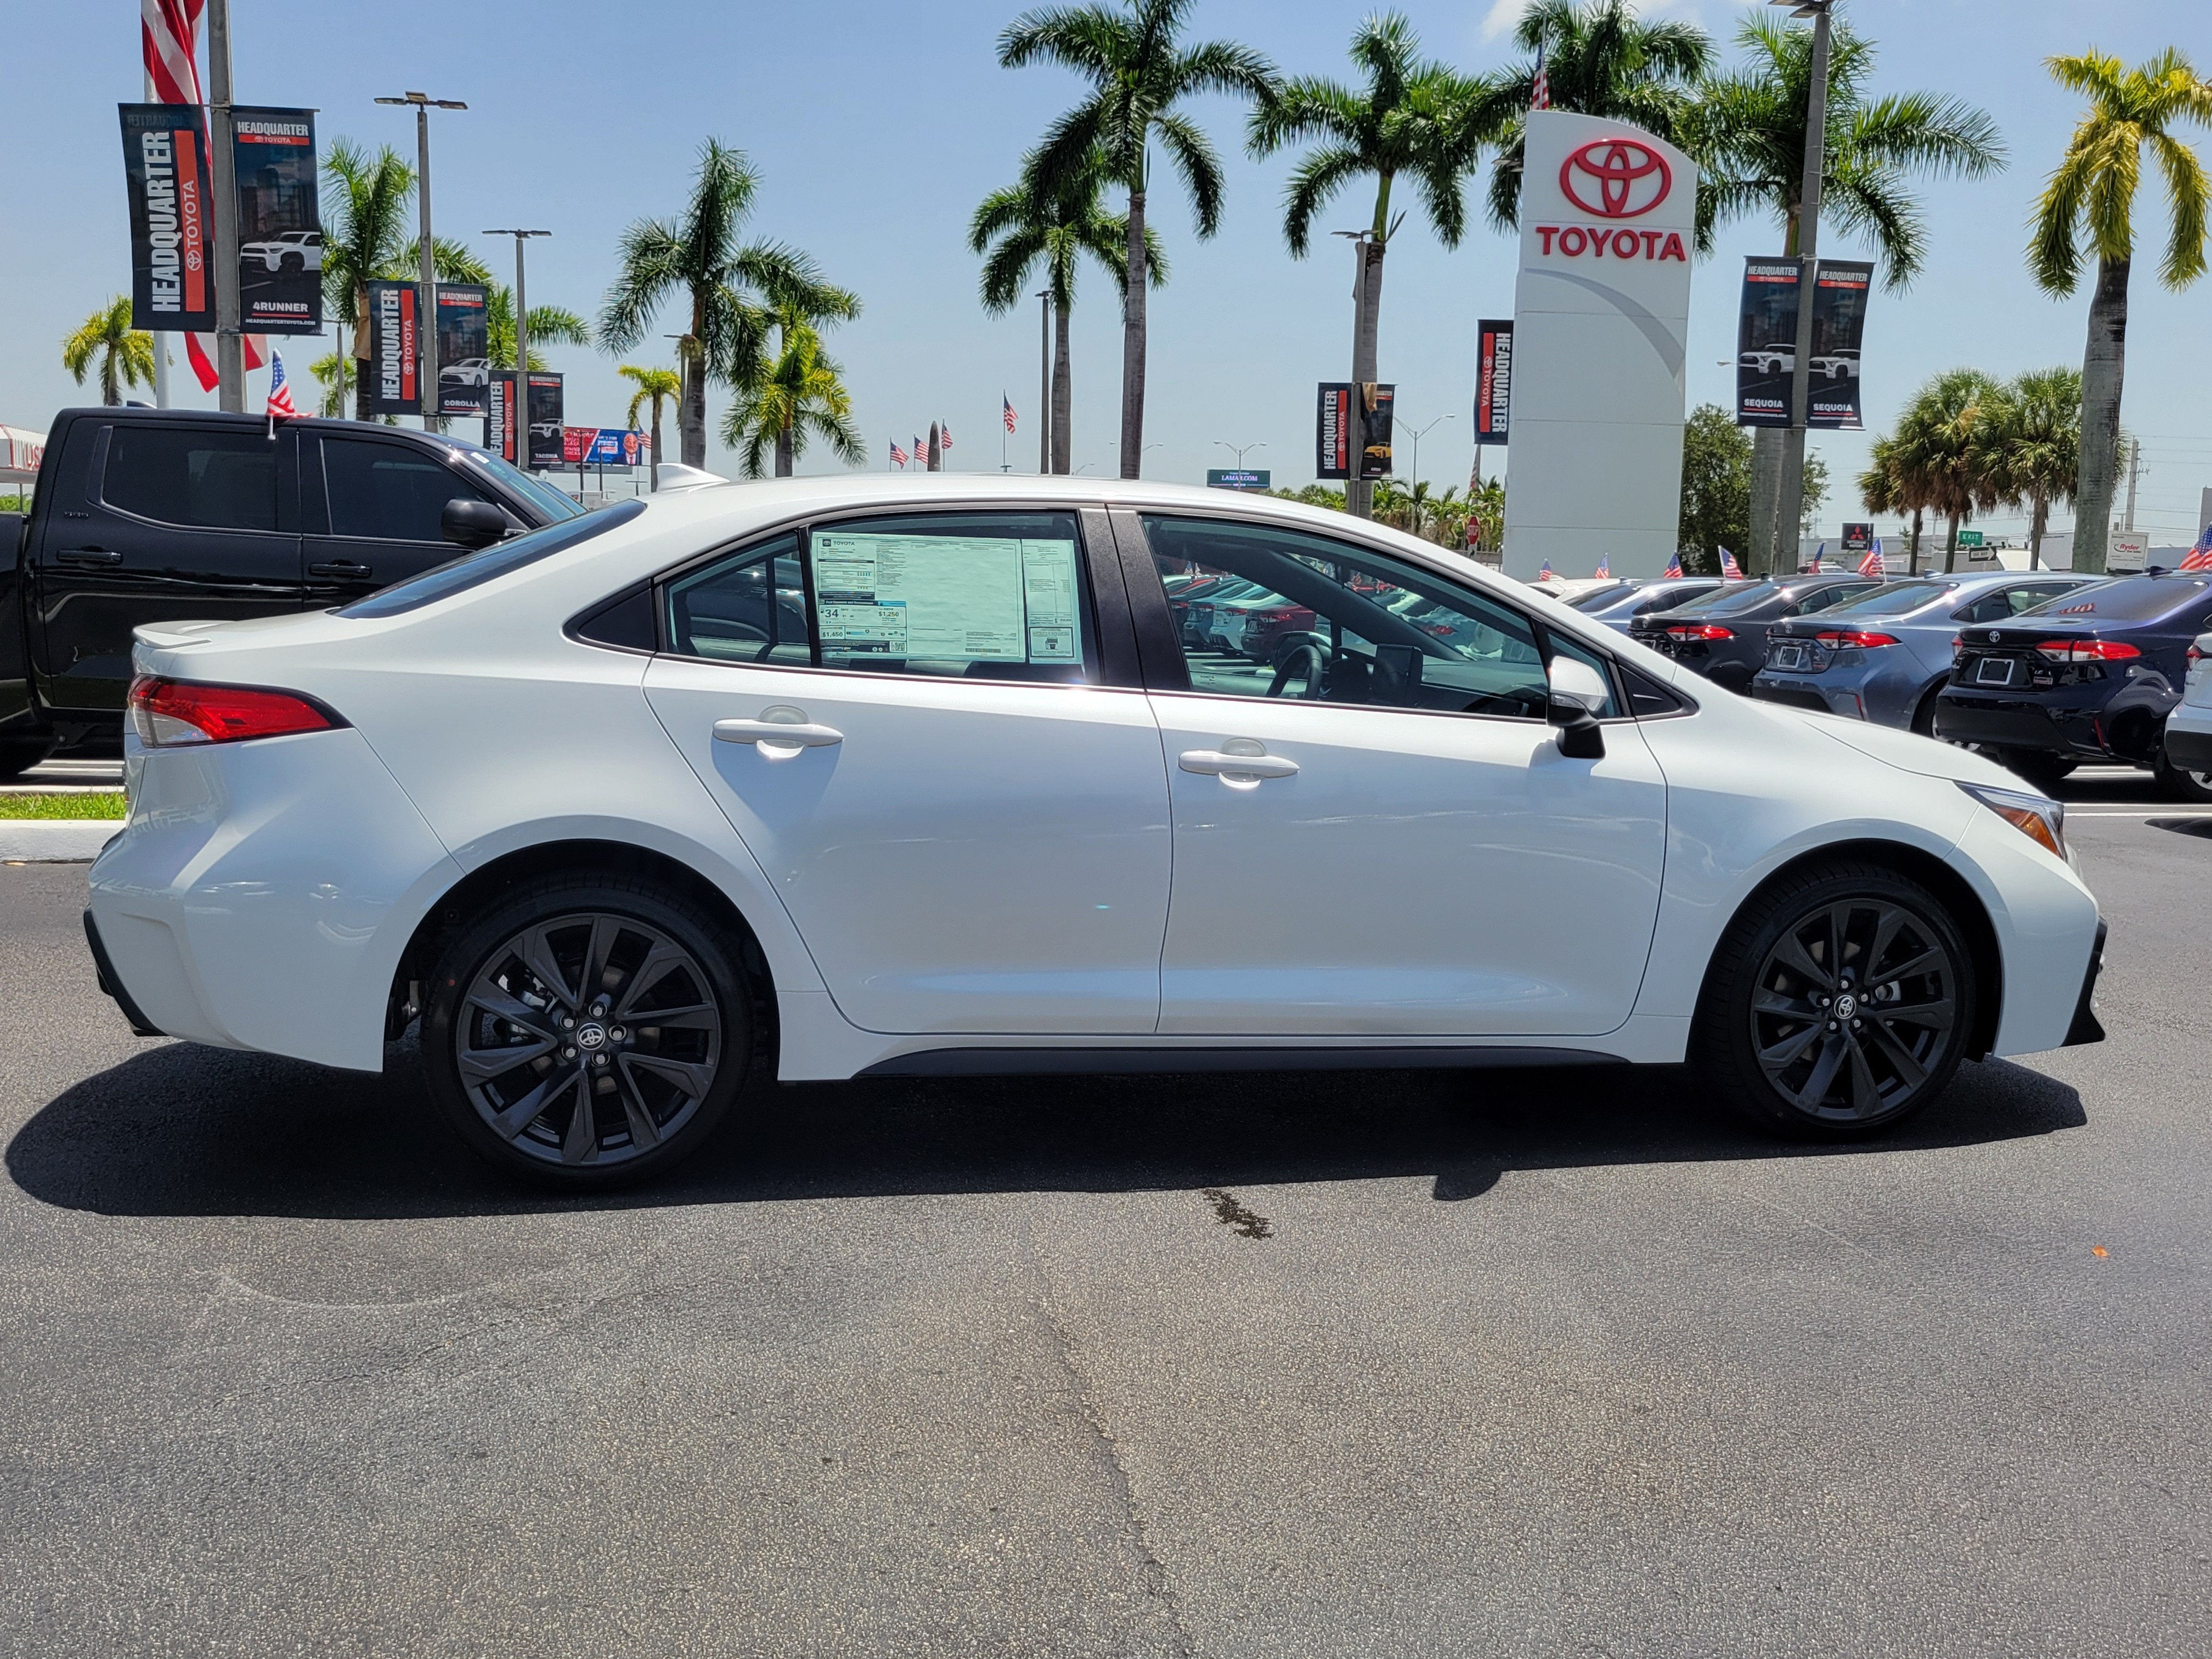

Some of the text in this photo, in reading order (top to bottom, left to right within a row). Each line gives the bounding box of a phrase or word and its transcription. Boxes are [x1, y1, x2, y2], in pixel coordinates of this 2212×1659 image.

[238, 121, 309, 136] HEADQUARTER
[142, 132, 183, 312] HEADQUARTER
[183, 180, 199, 249] TOYOTA
[1536, 227, 1686, 261] TOYOTA
[1748, 266, 1798, 276] HEADQUARTER
[1819, 270, 1867, 282] HEADQUARTER
[439, 291, 483, 302] HEADQUARTER
[253, 301, 308, 312] 4RUNNER
[381, 290, 403, 399] HEADQUARTER
[404, 320, 413, 361] TOYOTA
[1481, 368, 1491, 407] TOYOTA
[1492, 332, 1511, 433] HEADQUARTER
[1744, 398, 1784, 408] SEQUOIA
[1813, 403, 1853, 412] SEQUOIA
[1323, 390, 1338, 470] HEADQUARTER
[1468, 525, 1479, 537] STOP
[825, 609, 839, 618] 34
